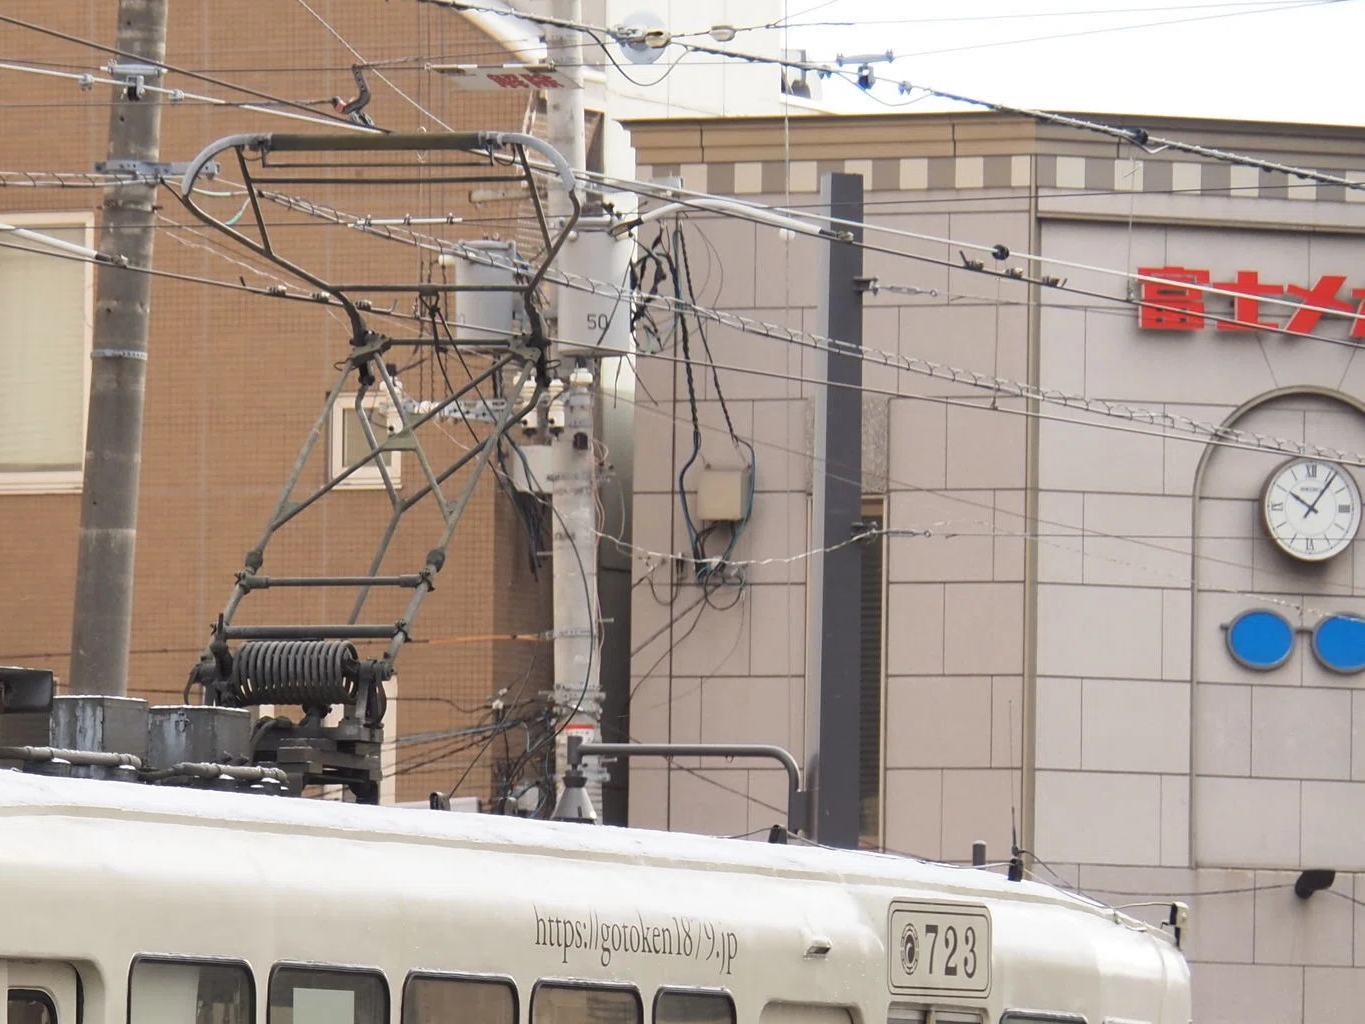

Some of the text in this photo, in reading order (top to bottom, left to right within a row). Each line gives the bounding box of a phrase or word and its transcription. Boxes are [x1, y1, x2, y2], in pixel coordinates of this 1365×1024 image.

[587, 313, 608, 330] 50
[1137, 266, 1365, 337] 富士メ
[924, 924, 977, 978] 723
